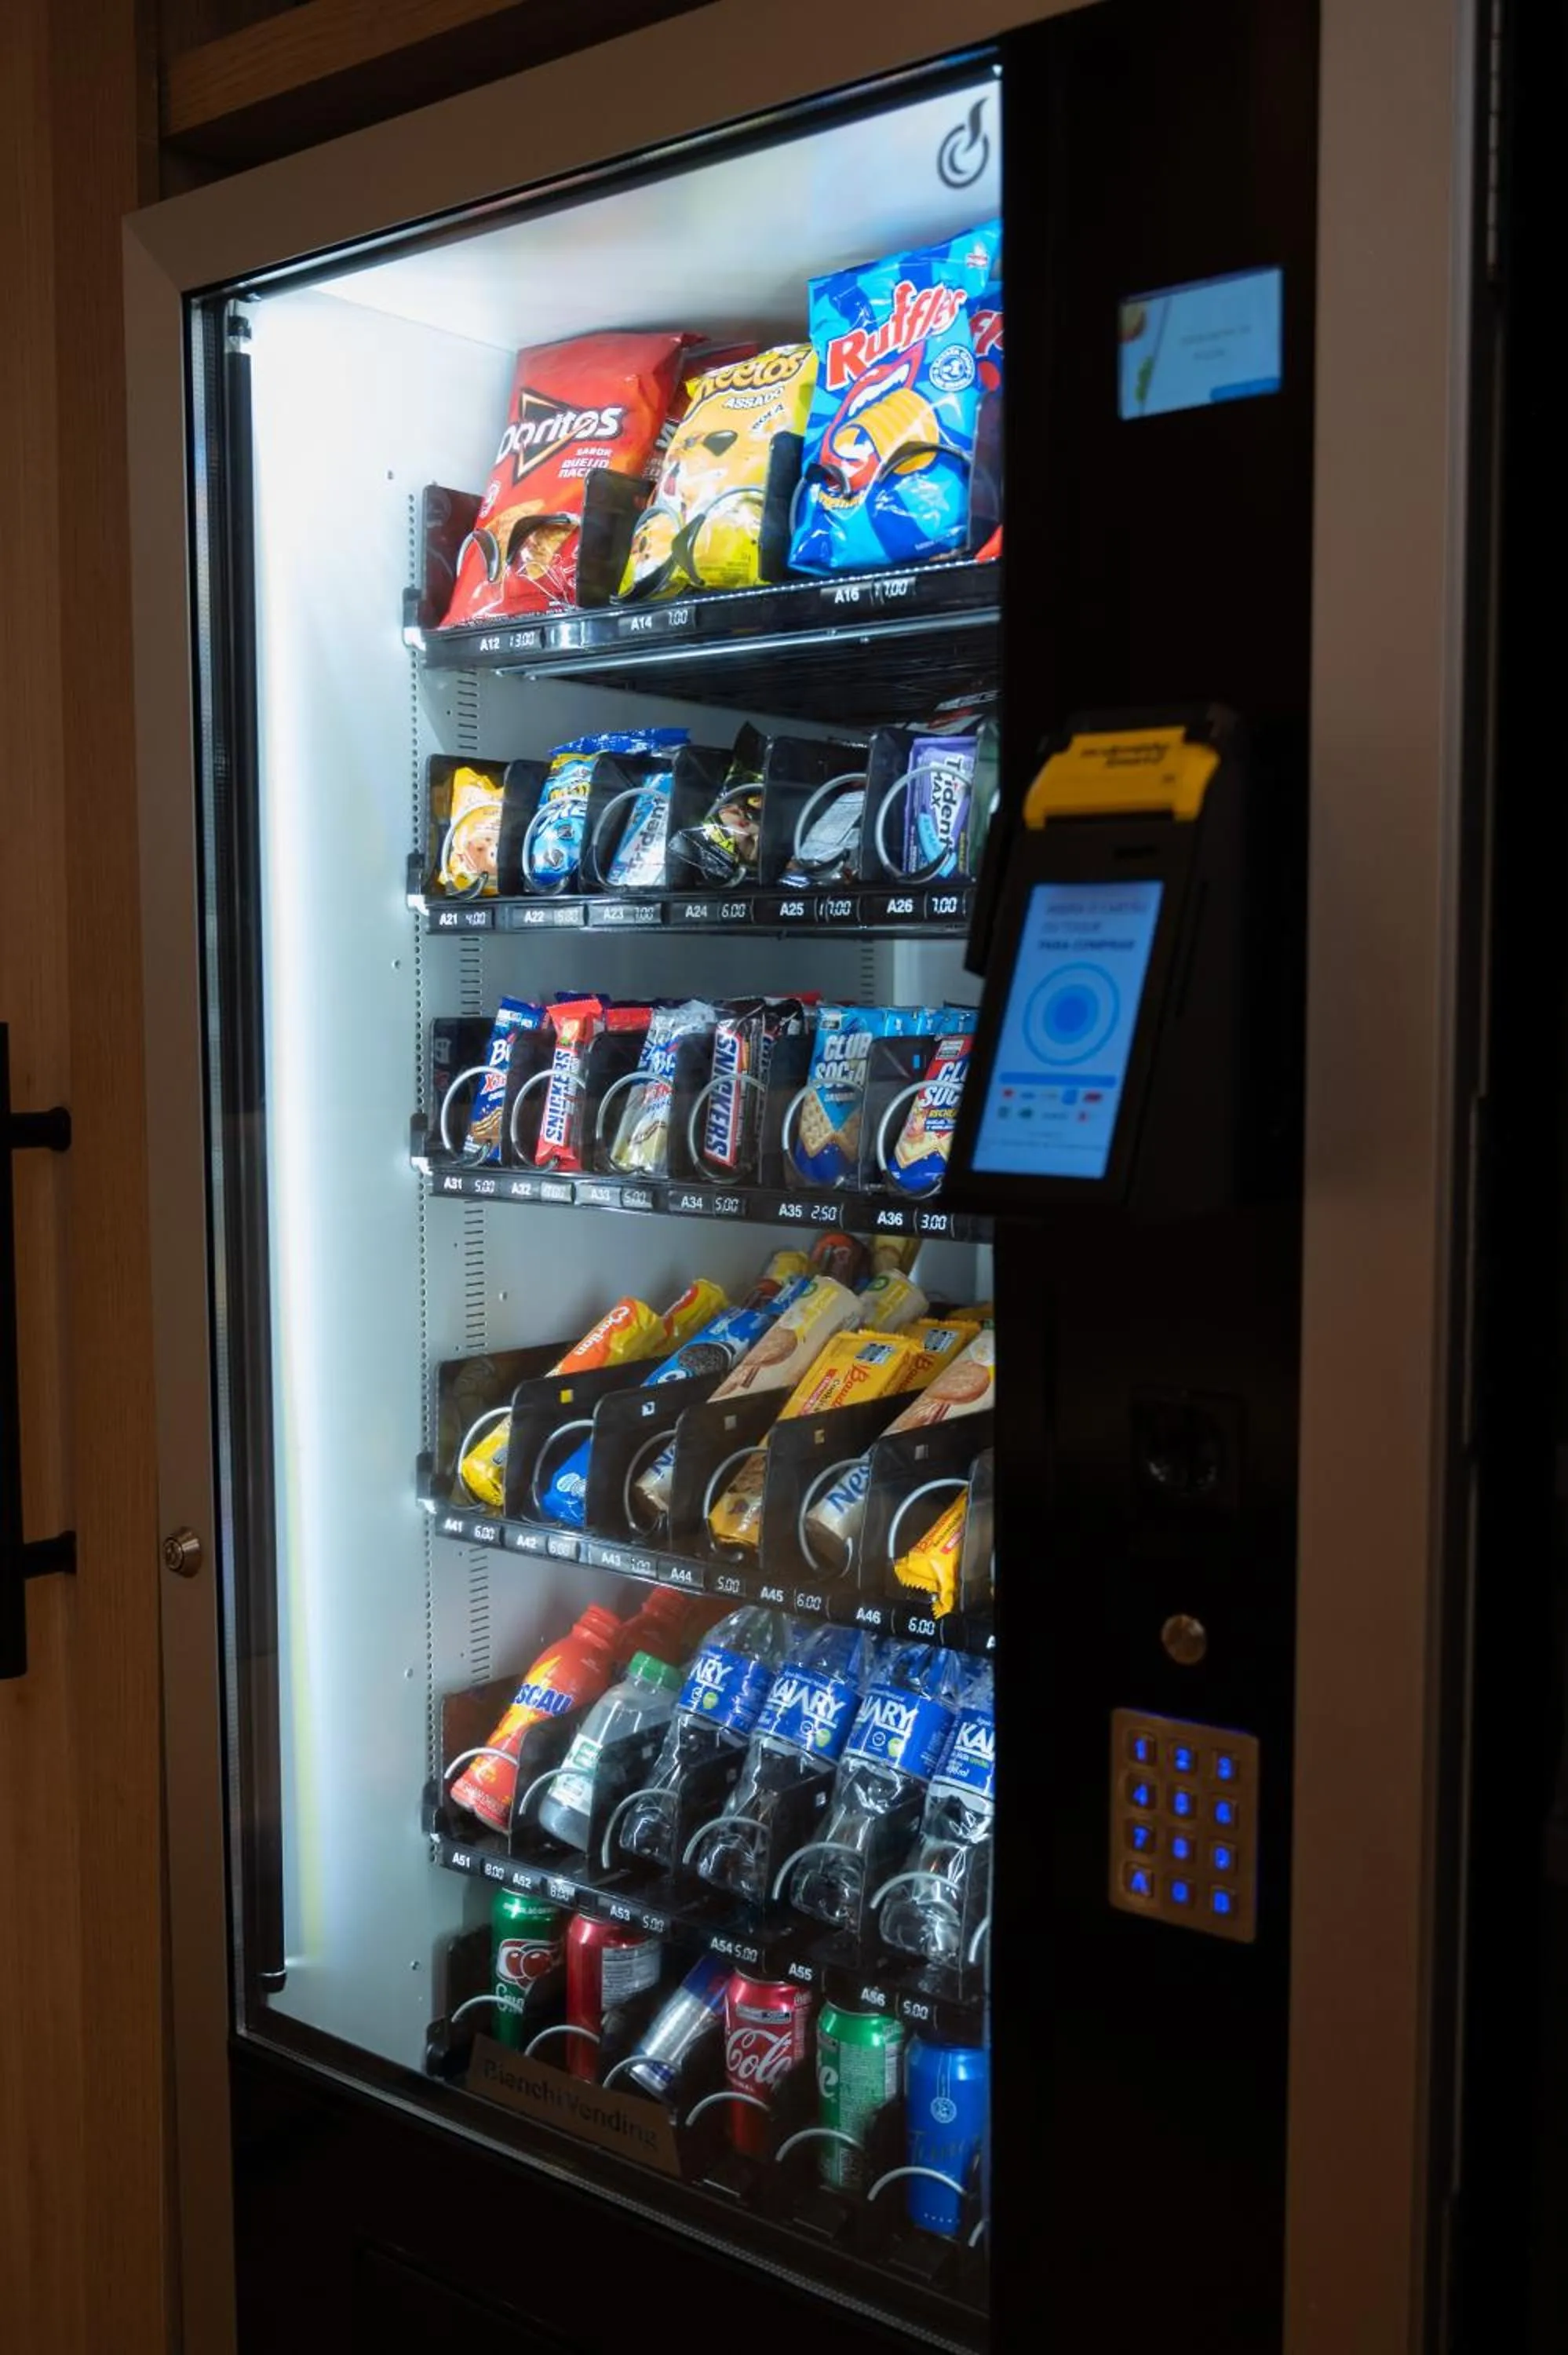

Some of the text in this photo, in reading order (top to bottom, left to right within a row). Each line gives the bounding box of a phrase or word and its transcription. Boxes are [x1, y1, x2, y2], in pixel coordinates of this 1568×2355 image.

[826, 279, 968, 392] Ruffles
[495, 407, 623, 465] Doritos
[575, 447, 613, 457] SABOR
[561, 458, 610, 469] QUEIJO
[834, 587, 859, 604] A16
[631, 616, 652, 631] A14
[480, 637, 500, 652] A12
[603, 907, 624, 920] A23
[685, 904, 707, 918] A24
[779, 901, 804, 916] A25
[886, 899, 913, 914] A26
[439, 913, 458, 926] A21
[523, 910, 545, 923] A22
[489, 1033, 515, 1066] Bi
[824, 1031, 873, 1061] CLUB
[815, 1059, 867, 1089] SOCIA
[706, 1033, 738, 1157] SNICKERS
[443, 1177, 462, 1190] A31
[511, 1182, 532, 1196] A32
[591, 1187, 610, 1201] A33
[680, 1195, 703, 1210] A34
[779, 1203, 802, 1218] A35
[877, 1211, 903, 1226] A36
[444, 1517, 463, 1532] A41
[516, 1534, 536, 1549] A42
[601, 1551, 622, 1566] A43
[670, 1568, 692, 1583] A44
[760, 1586, 784, 1603] A45
[856, 1606, 881, 1625] A46
[513, 1682, 574, 1717] SCAU
[1135, 1740, 1146, 1760] 1
[451, 1852, 470, 1868] A51
[512, 1872, 531, 1889] A52
[610, 1904, 630, 1921] A53
[710, 1937, 732, 1954] A54
[788, 1962, 812, 1981] A55
[861, 1988, 885, 2007] A56
